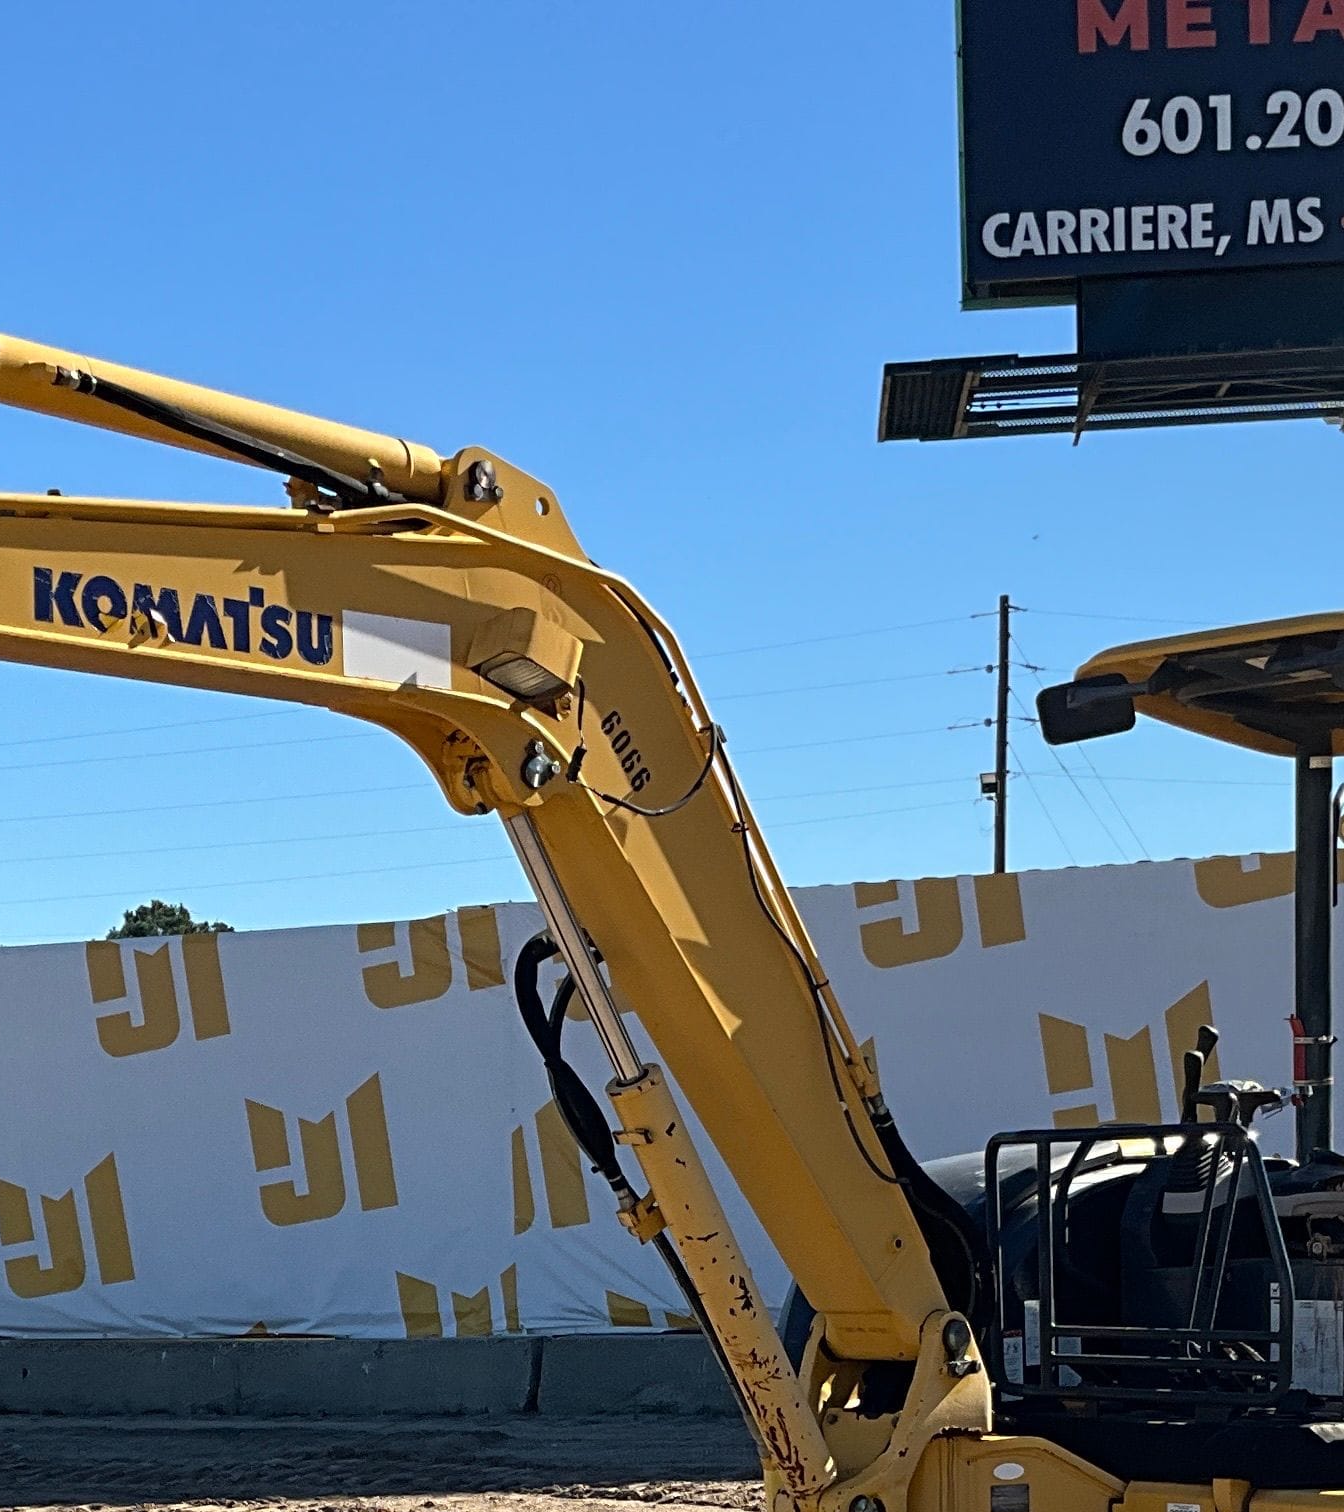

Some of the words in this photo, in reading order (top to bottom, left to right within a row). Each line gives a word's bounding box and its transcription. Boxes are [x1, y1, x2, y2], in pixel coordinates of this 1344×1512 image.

[981, 202, 1232, 258] CARRIERE,
[1246, 197, 1324, 246] MS
[33, 566, 334, 666] KOMATSU
[600, 709, 652, 793] 6066
